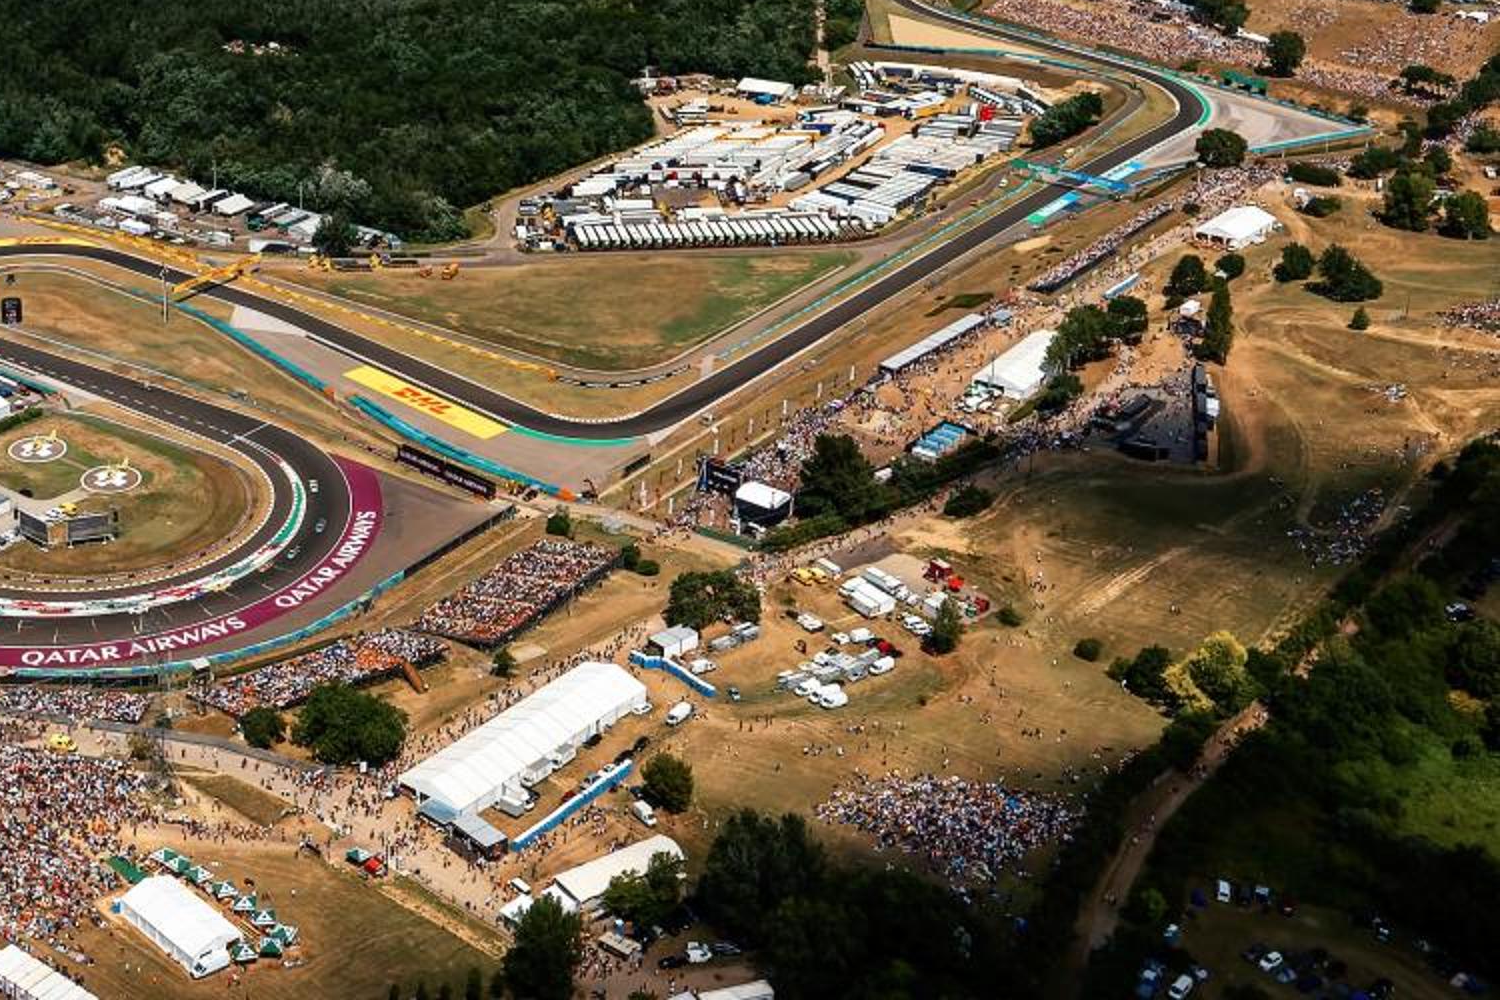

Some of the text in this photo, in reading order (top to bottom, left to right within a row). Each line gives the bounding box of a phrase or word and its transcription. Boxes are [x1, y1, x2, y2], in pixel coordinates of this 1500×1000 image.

[391, 387, 452, 414] DHL
[274, 510, 377, 608] QATAR AIRWAYS
[21, 616, 247, 666] QATAR AIRWAYS
